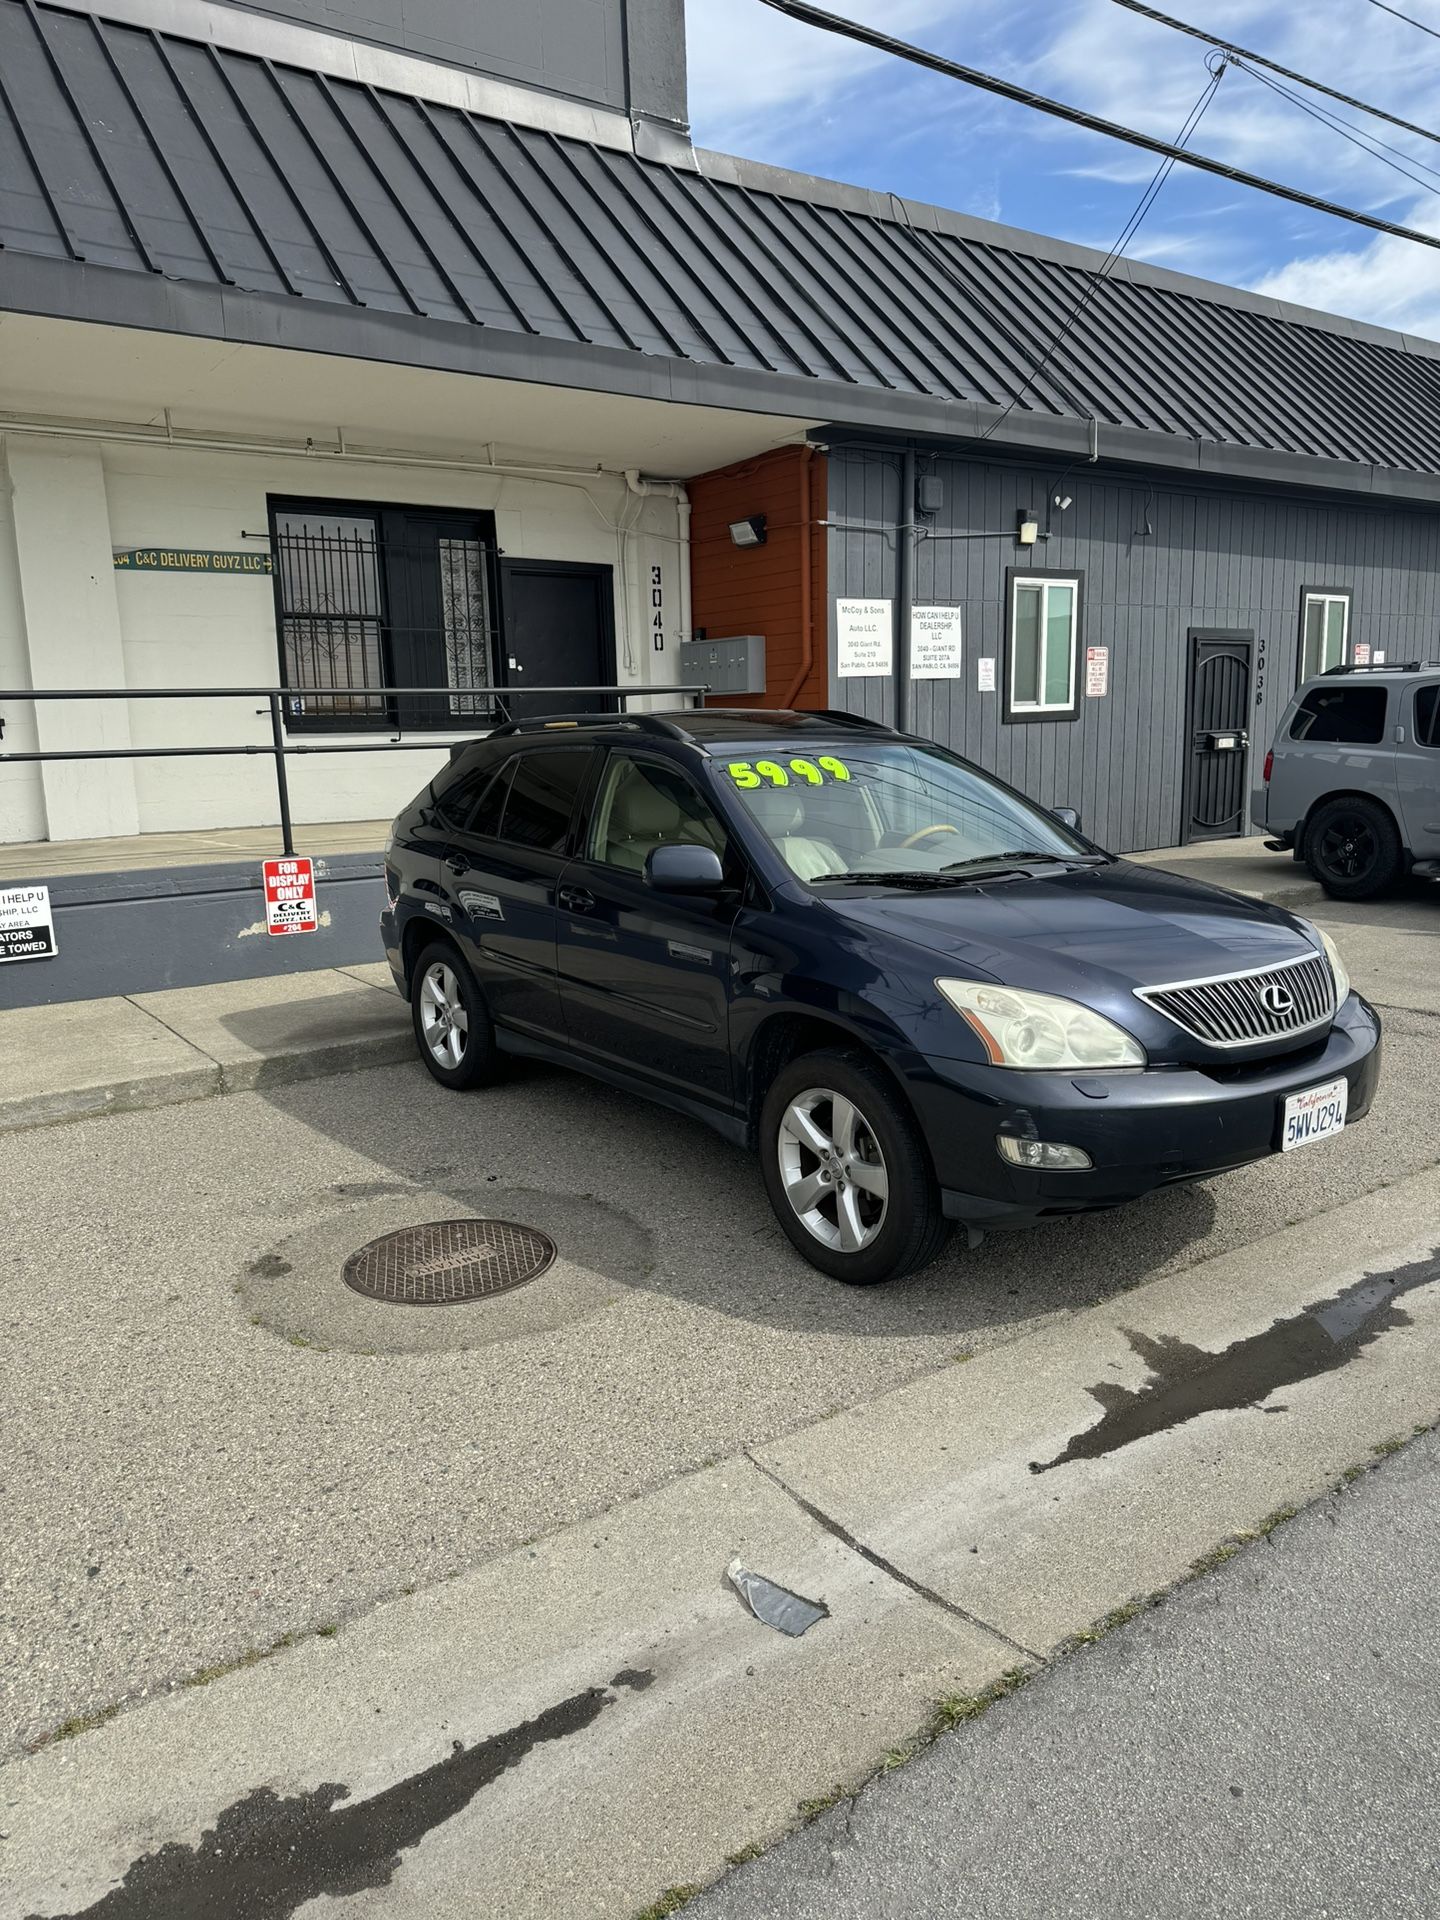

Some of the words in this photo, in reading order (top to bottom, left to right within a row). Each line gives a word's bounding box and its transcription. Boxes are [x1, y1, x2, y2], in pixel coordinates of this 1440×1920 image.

[136, 552, 157, 566] C&C
[161, 552, 210, 568] DELIVERY
[213, 555, 240, 569] GUYZ
[243, 556, 261, 570] LLC
[652, 566, 663, 651] 3040
[842, 606, 862, 615] McCoy
[955, 612, 959, 620] U
[729, 756, 850, 788] 5999
[278, 862, 298, 874] FOR
[269, 874, 310, 887] DISPLAY
[8, 893, 34, 903] HELP
[37, 892, 44, 900] U
[277, 886, 304, 900] ONLY
[21, 906, 38, 914] LLC
[278, 901, 306, 911] C&C
[0, 930, 33, 942] ATORS
[7, 941, 47, 953] TOWED
[1298, 1092, 1336, 1109] California
[1288, 1101, 1342, 1142] 5WVJ294
